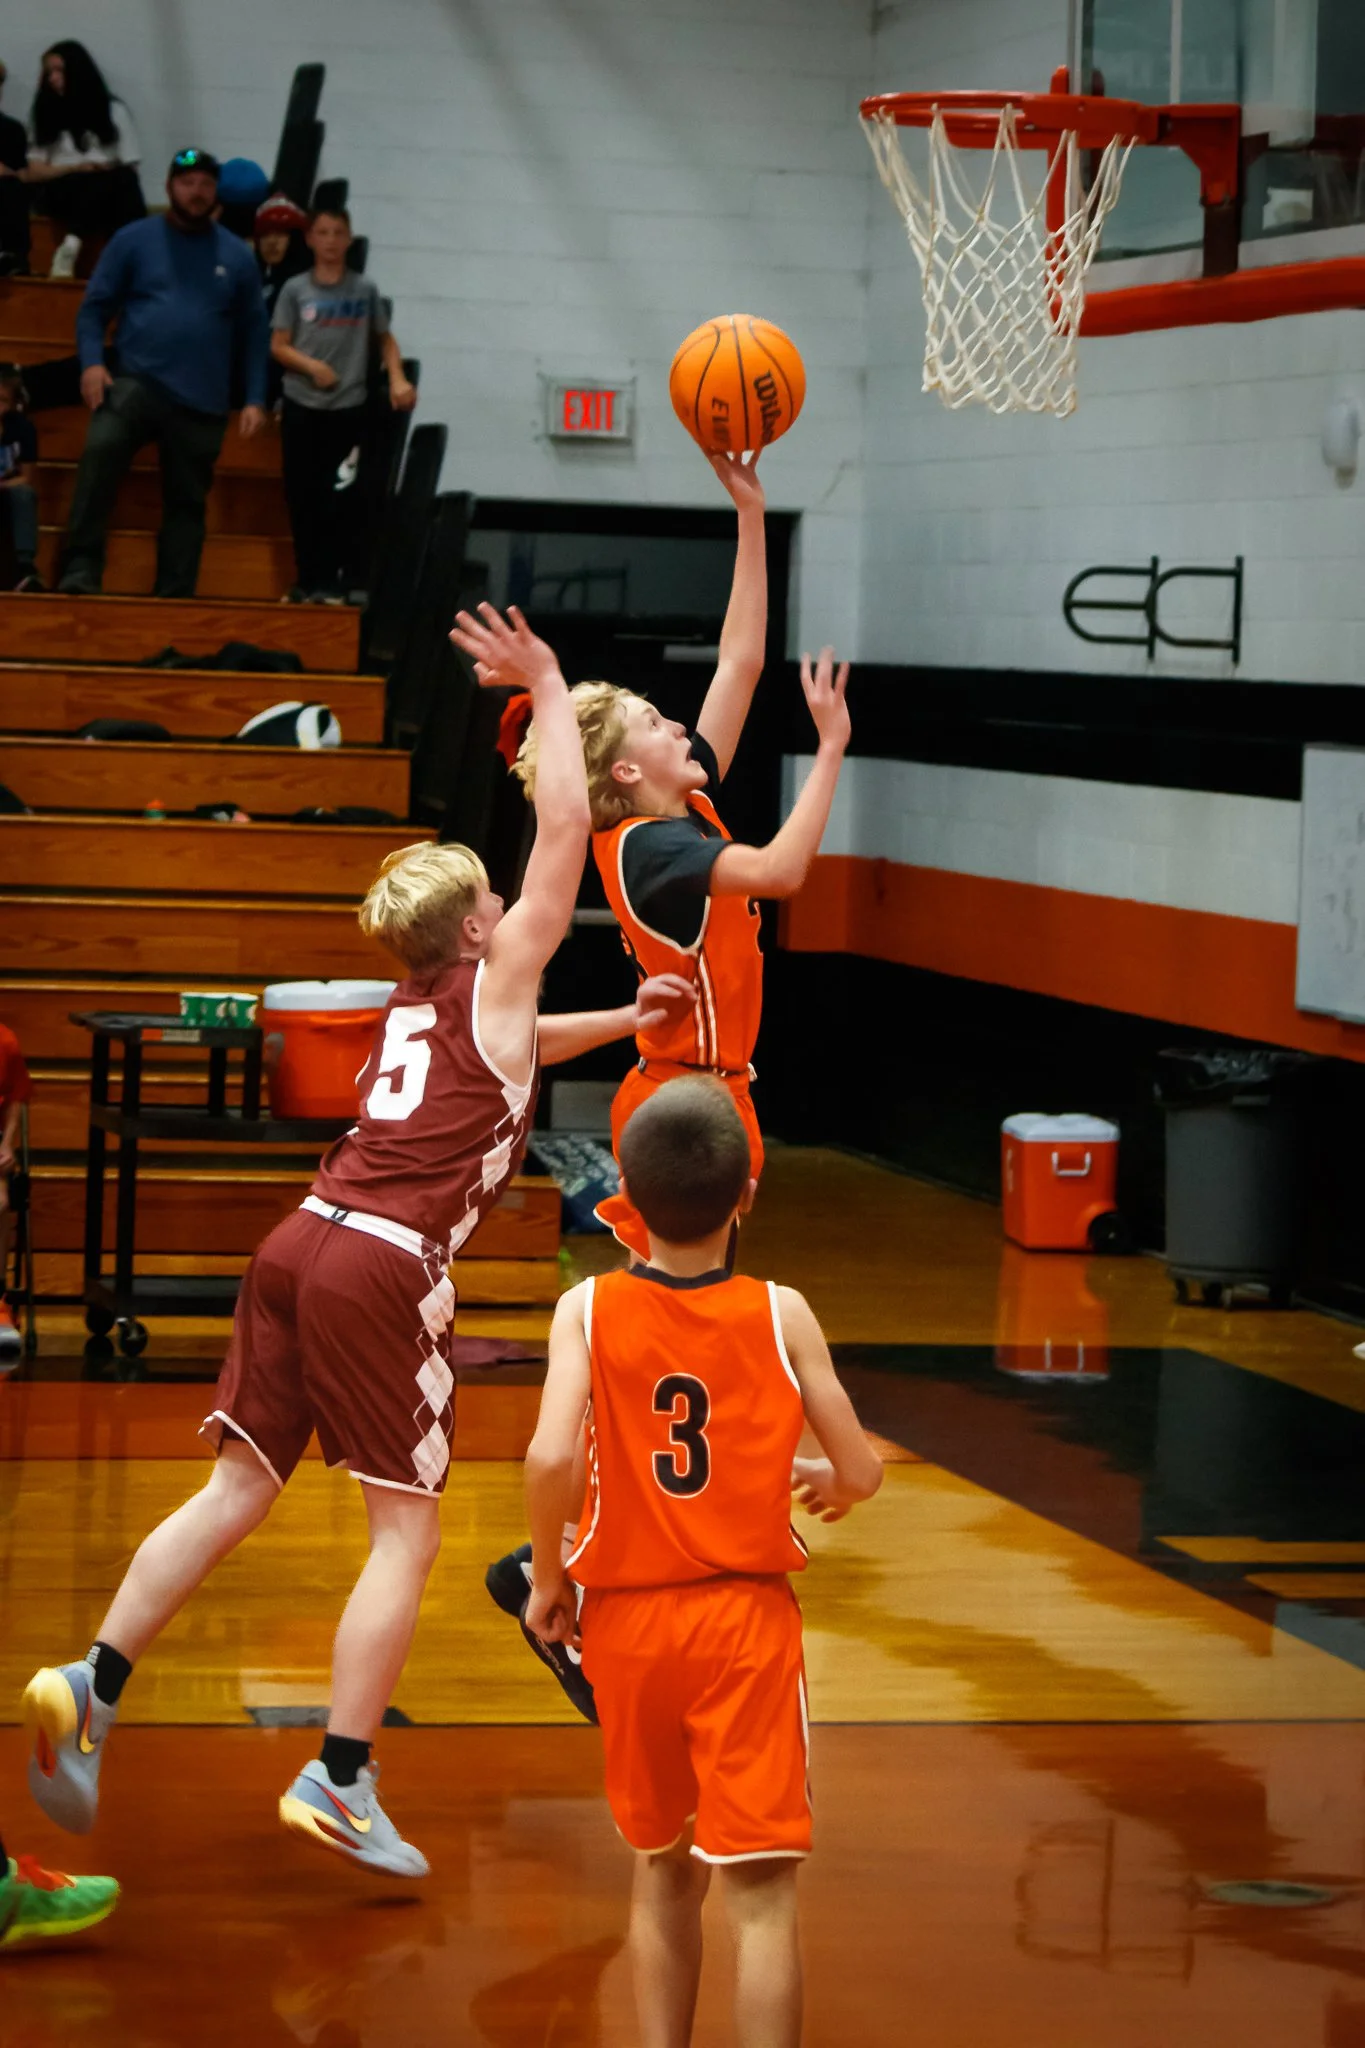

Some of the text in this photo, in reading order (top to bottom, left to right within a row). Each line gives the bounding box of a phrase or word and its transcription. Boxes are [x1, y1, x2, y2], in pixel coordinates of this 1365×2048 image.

[564, 389, 616, 432] EXIT
[366, 1003, 437, 1121] 5
[652, 1372, 711, 1499] 3
